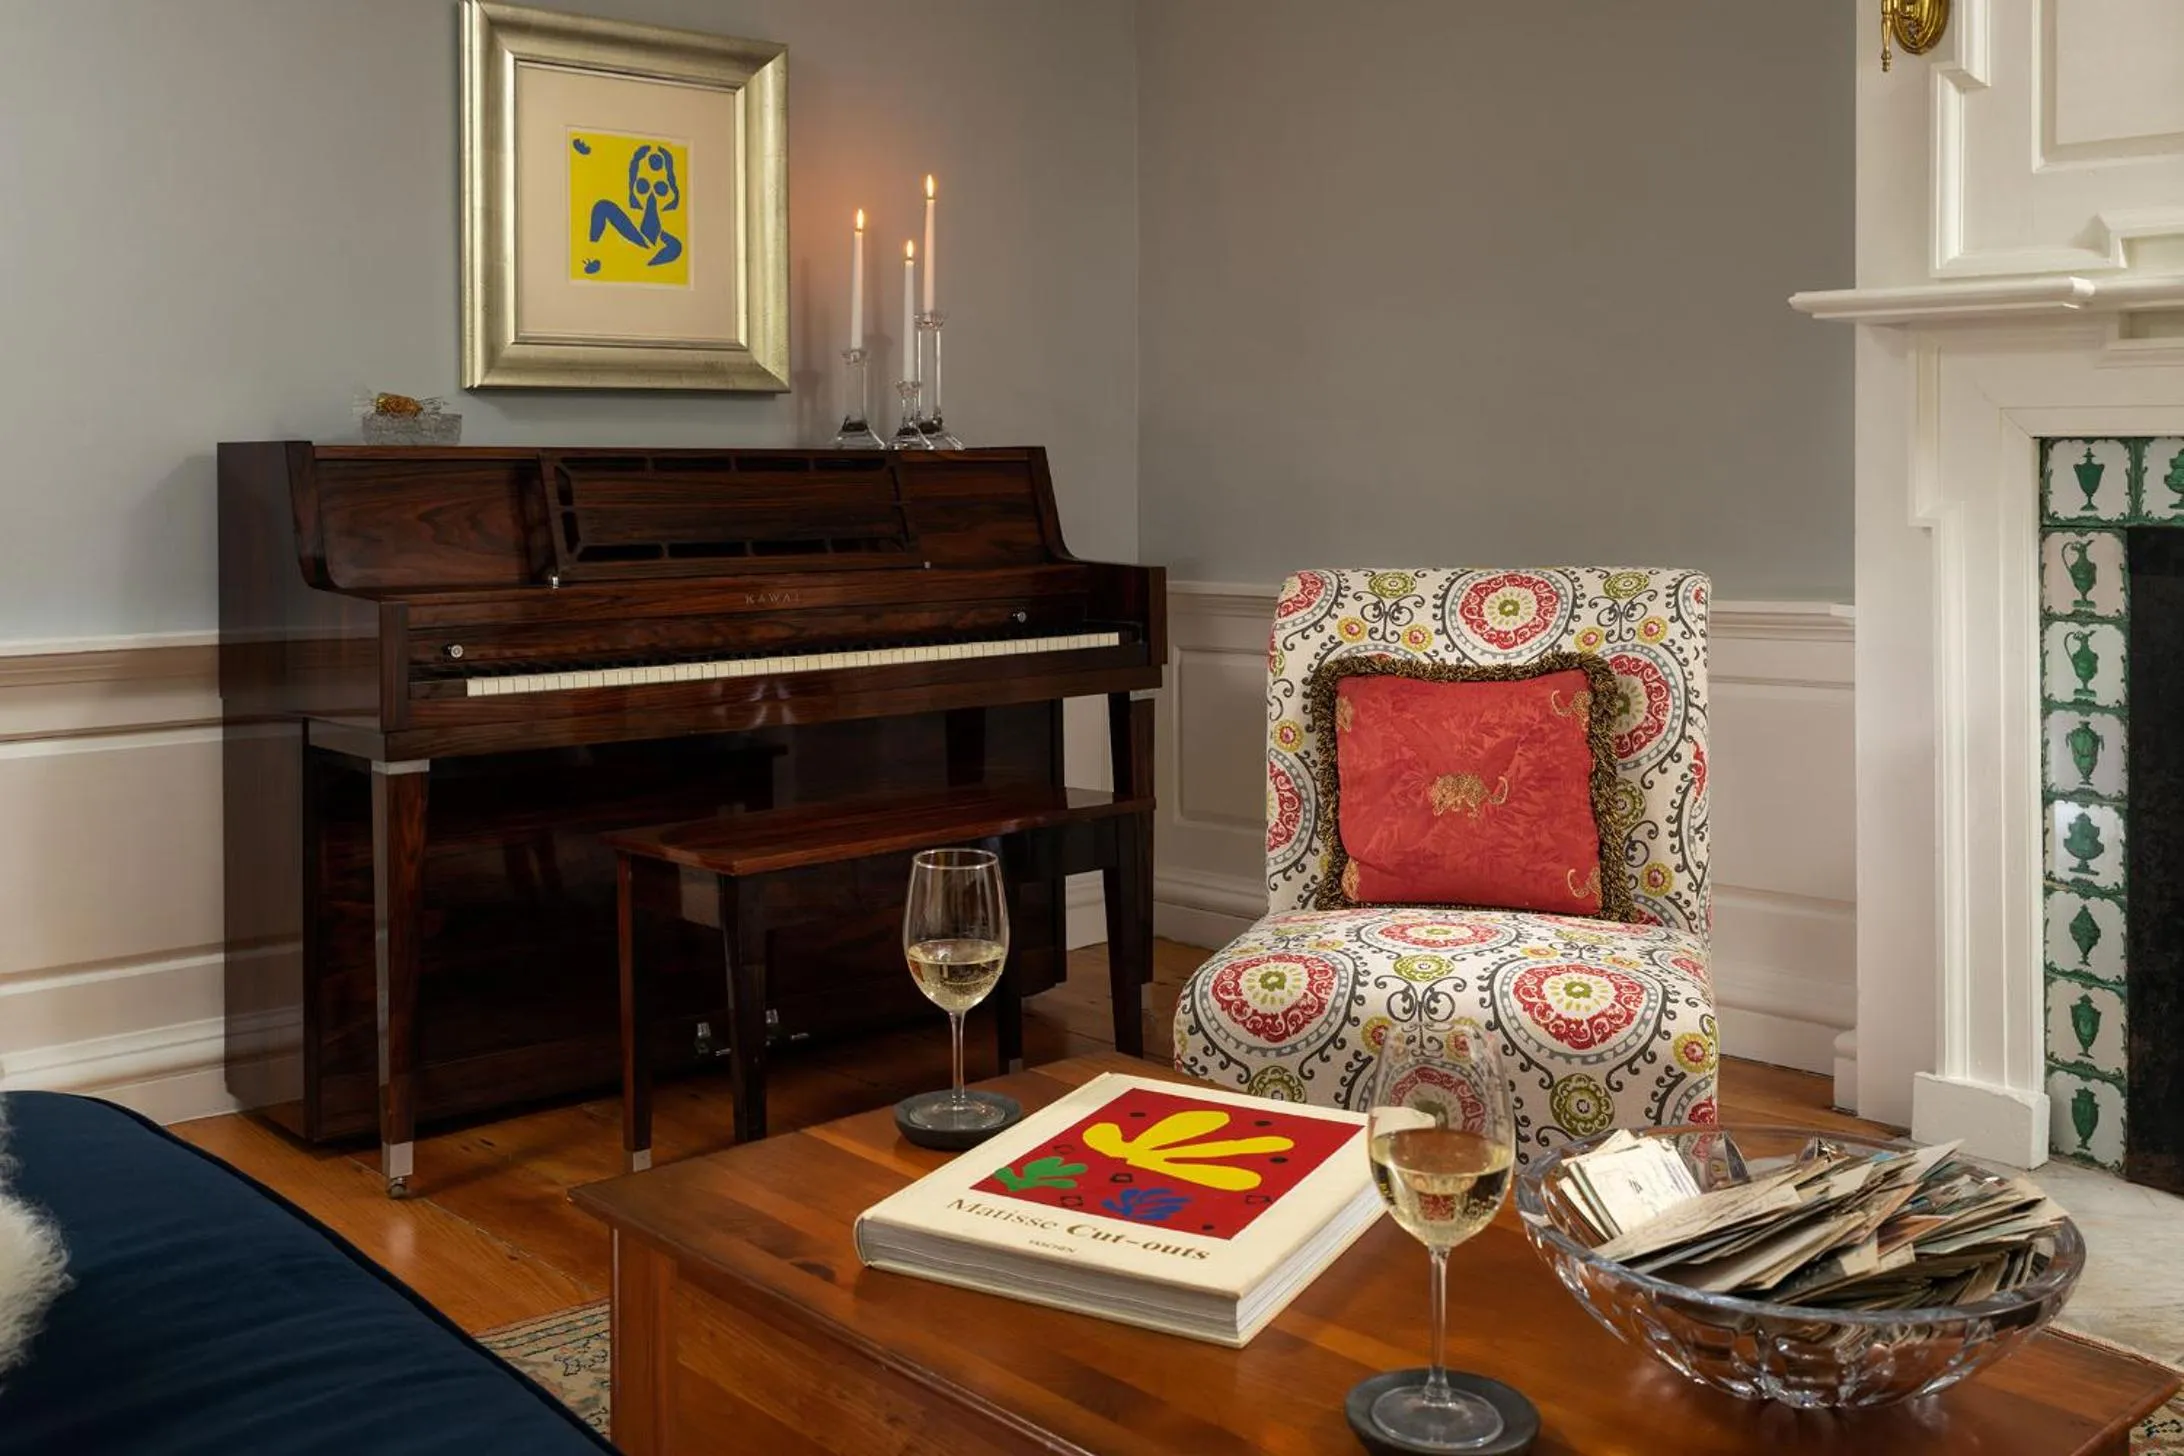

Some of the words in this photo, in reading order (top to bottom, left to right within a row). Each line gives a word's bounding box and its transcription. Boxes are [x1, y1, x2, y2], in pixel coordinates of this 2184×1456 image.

[744, 592, 799, 605] KAWAI
[946, 1198, 1059, 1230] Matisse
[1066, 1223, 1211, 1261] Cut-outs
